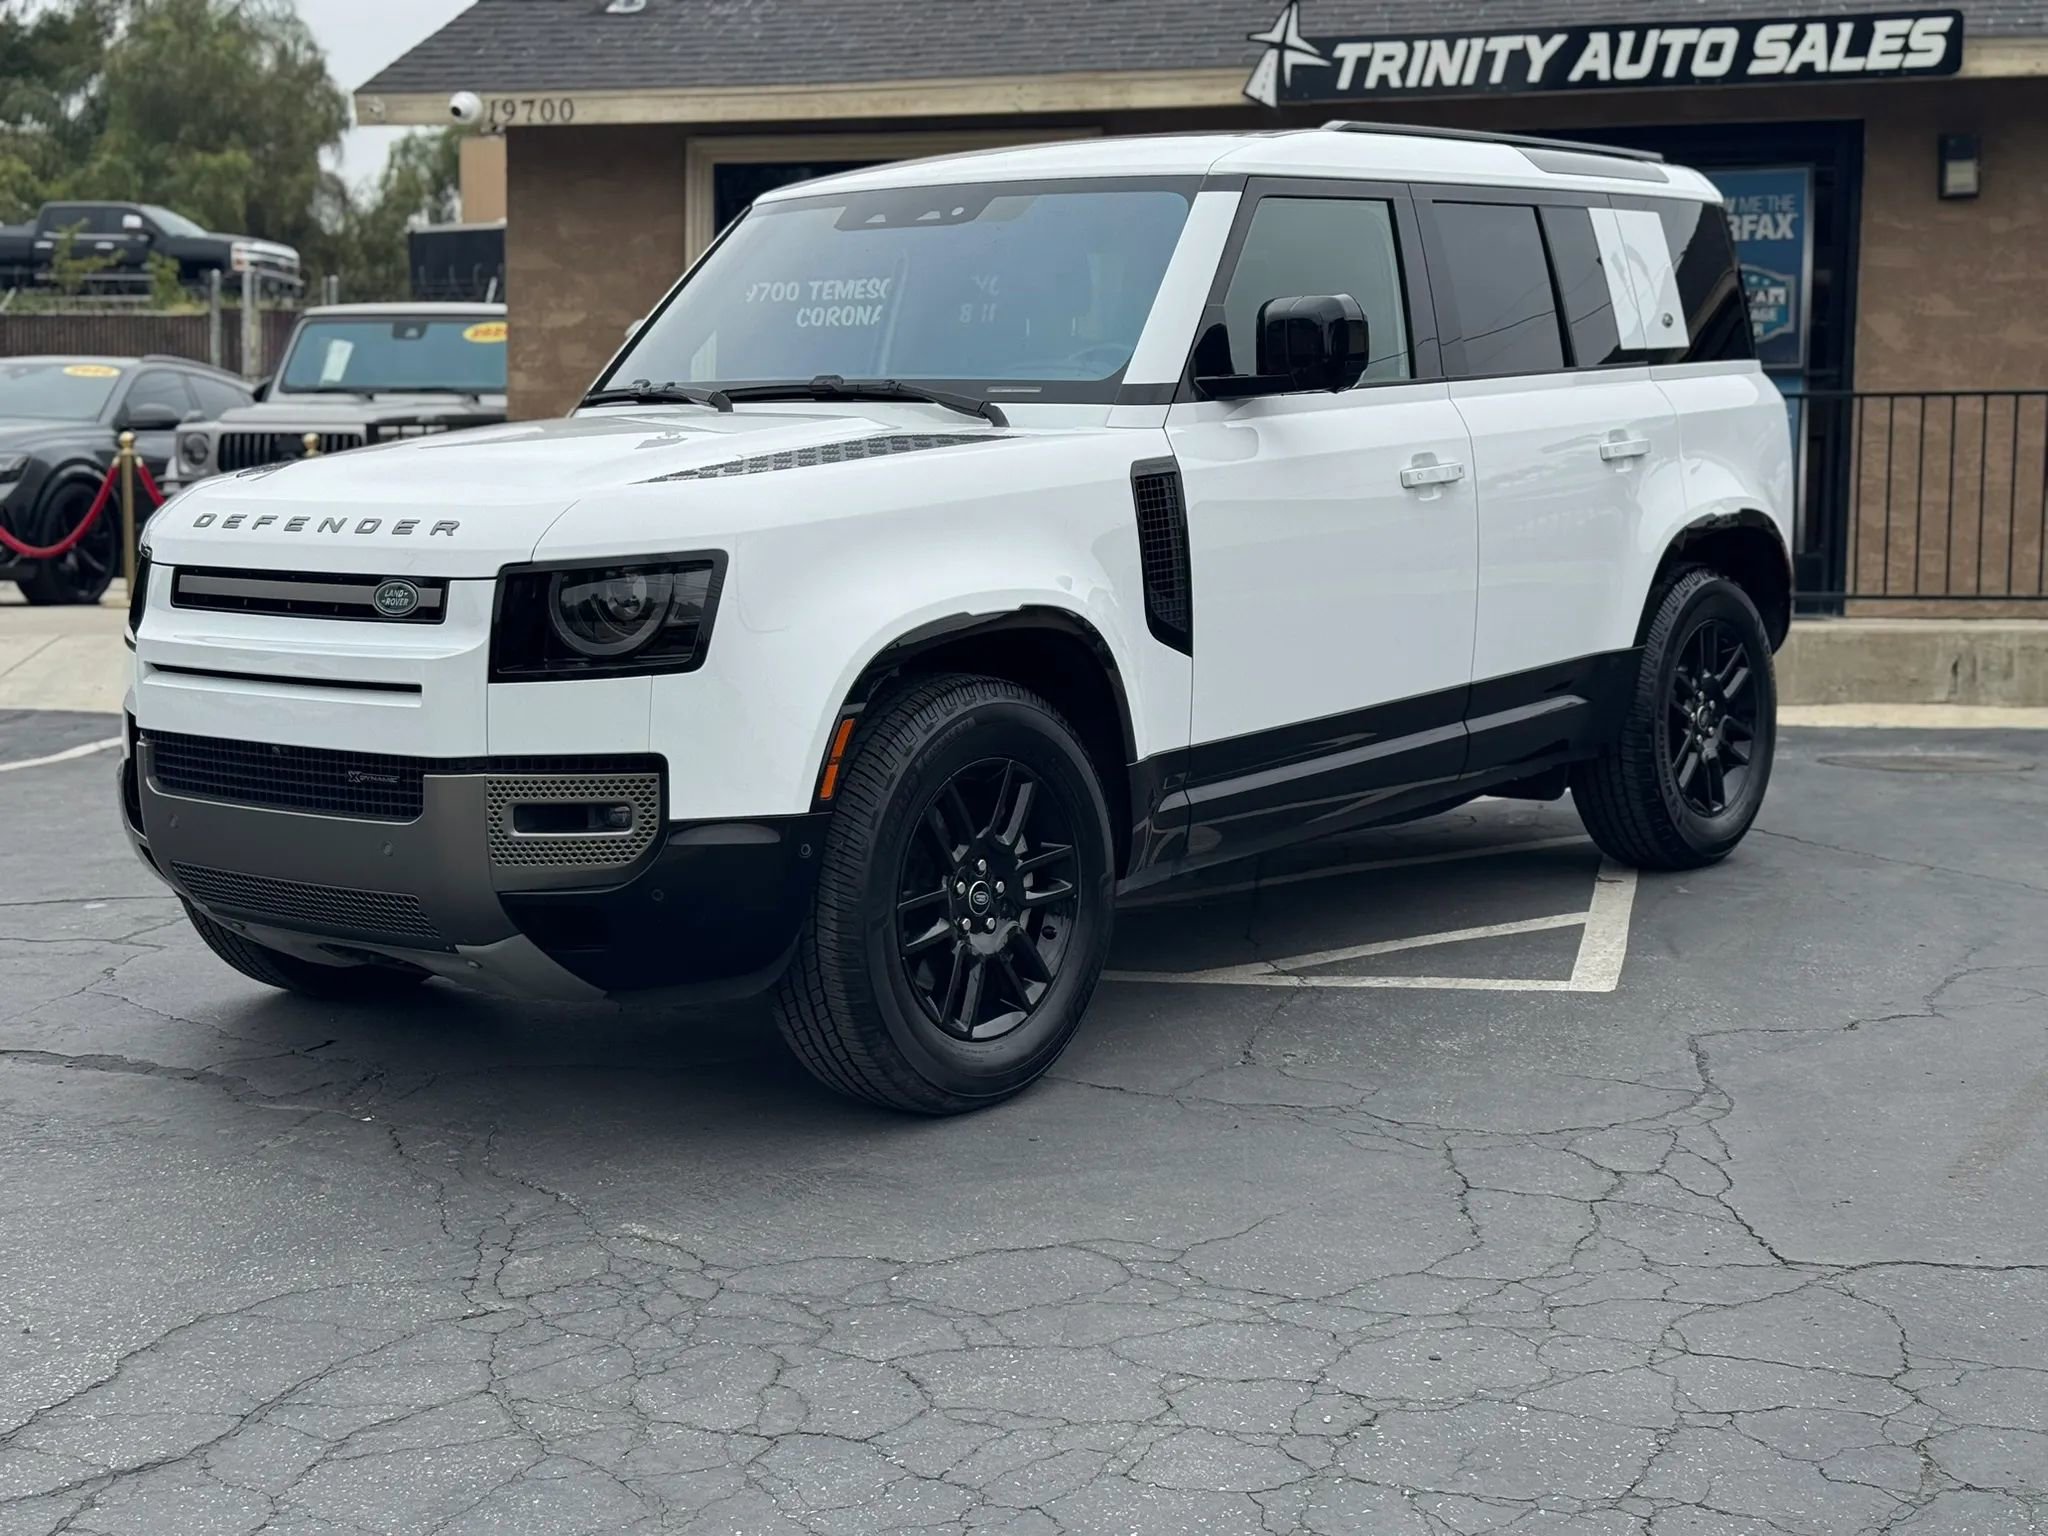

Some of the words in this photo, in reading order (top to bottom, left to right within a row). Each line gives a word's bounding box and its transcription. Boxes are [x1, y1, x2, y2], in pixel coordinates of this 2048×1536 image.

[1331, 34, 1568, 90] TRINITY
[1567, 26, 1740, 82] AUTO
[1747, 17, 1955, 75] SALES
[488, 97, 575, 123] 19700
[1768, 194, 1795, 212] THE
[1727, 213, 1798, 241] RFAX
[192, 513, 461, 537] DEFENDER
